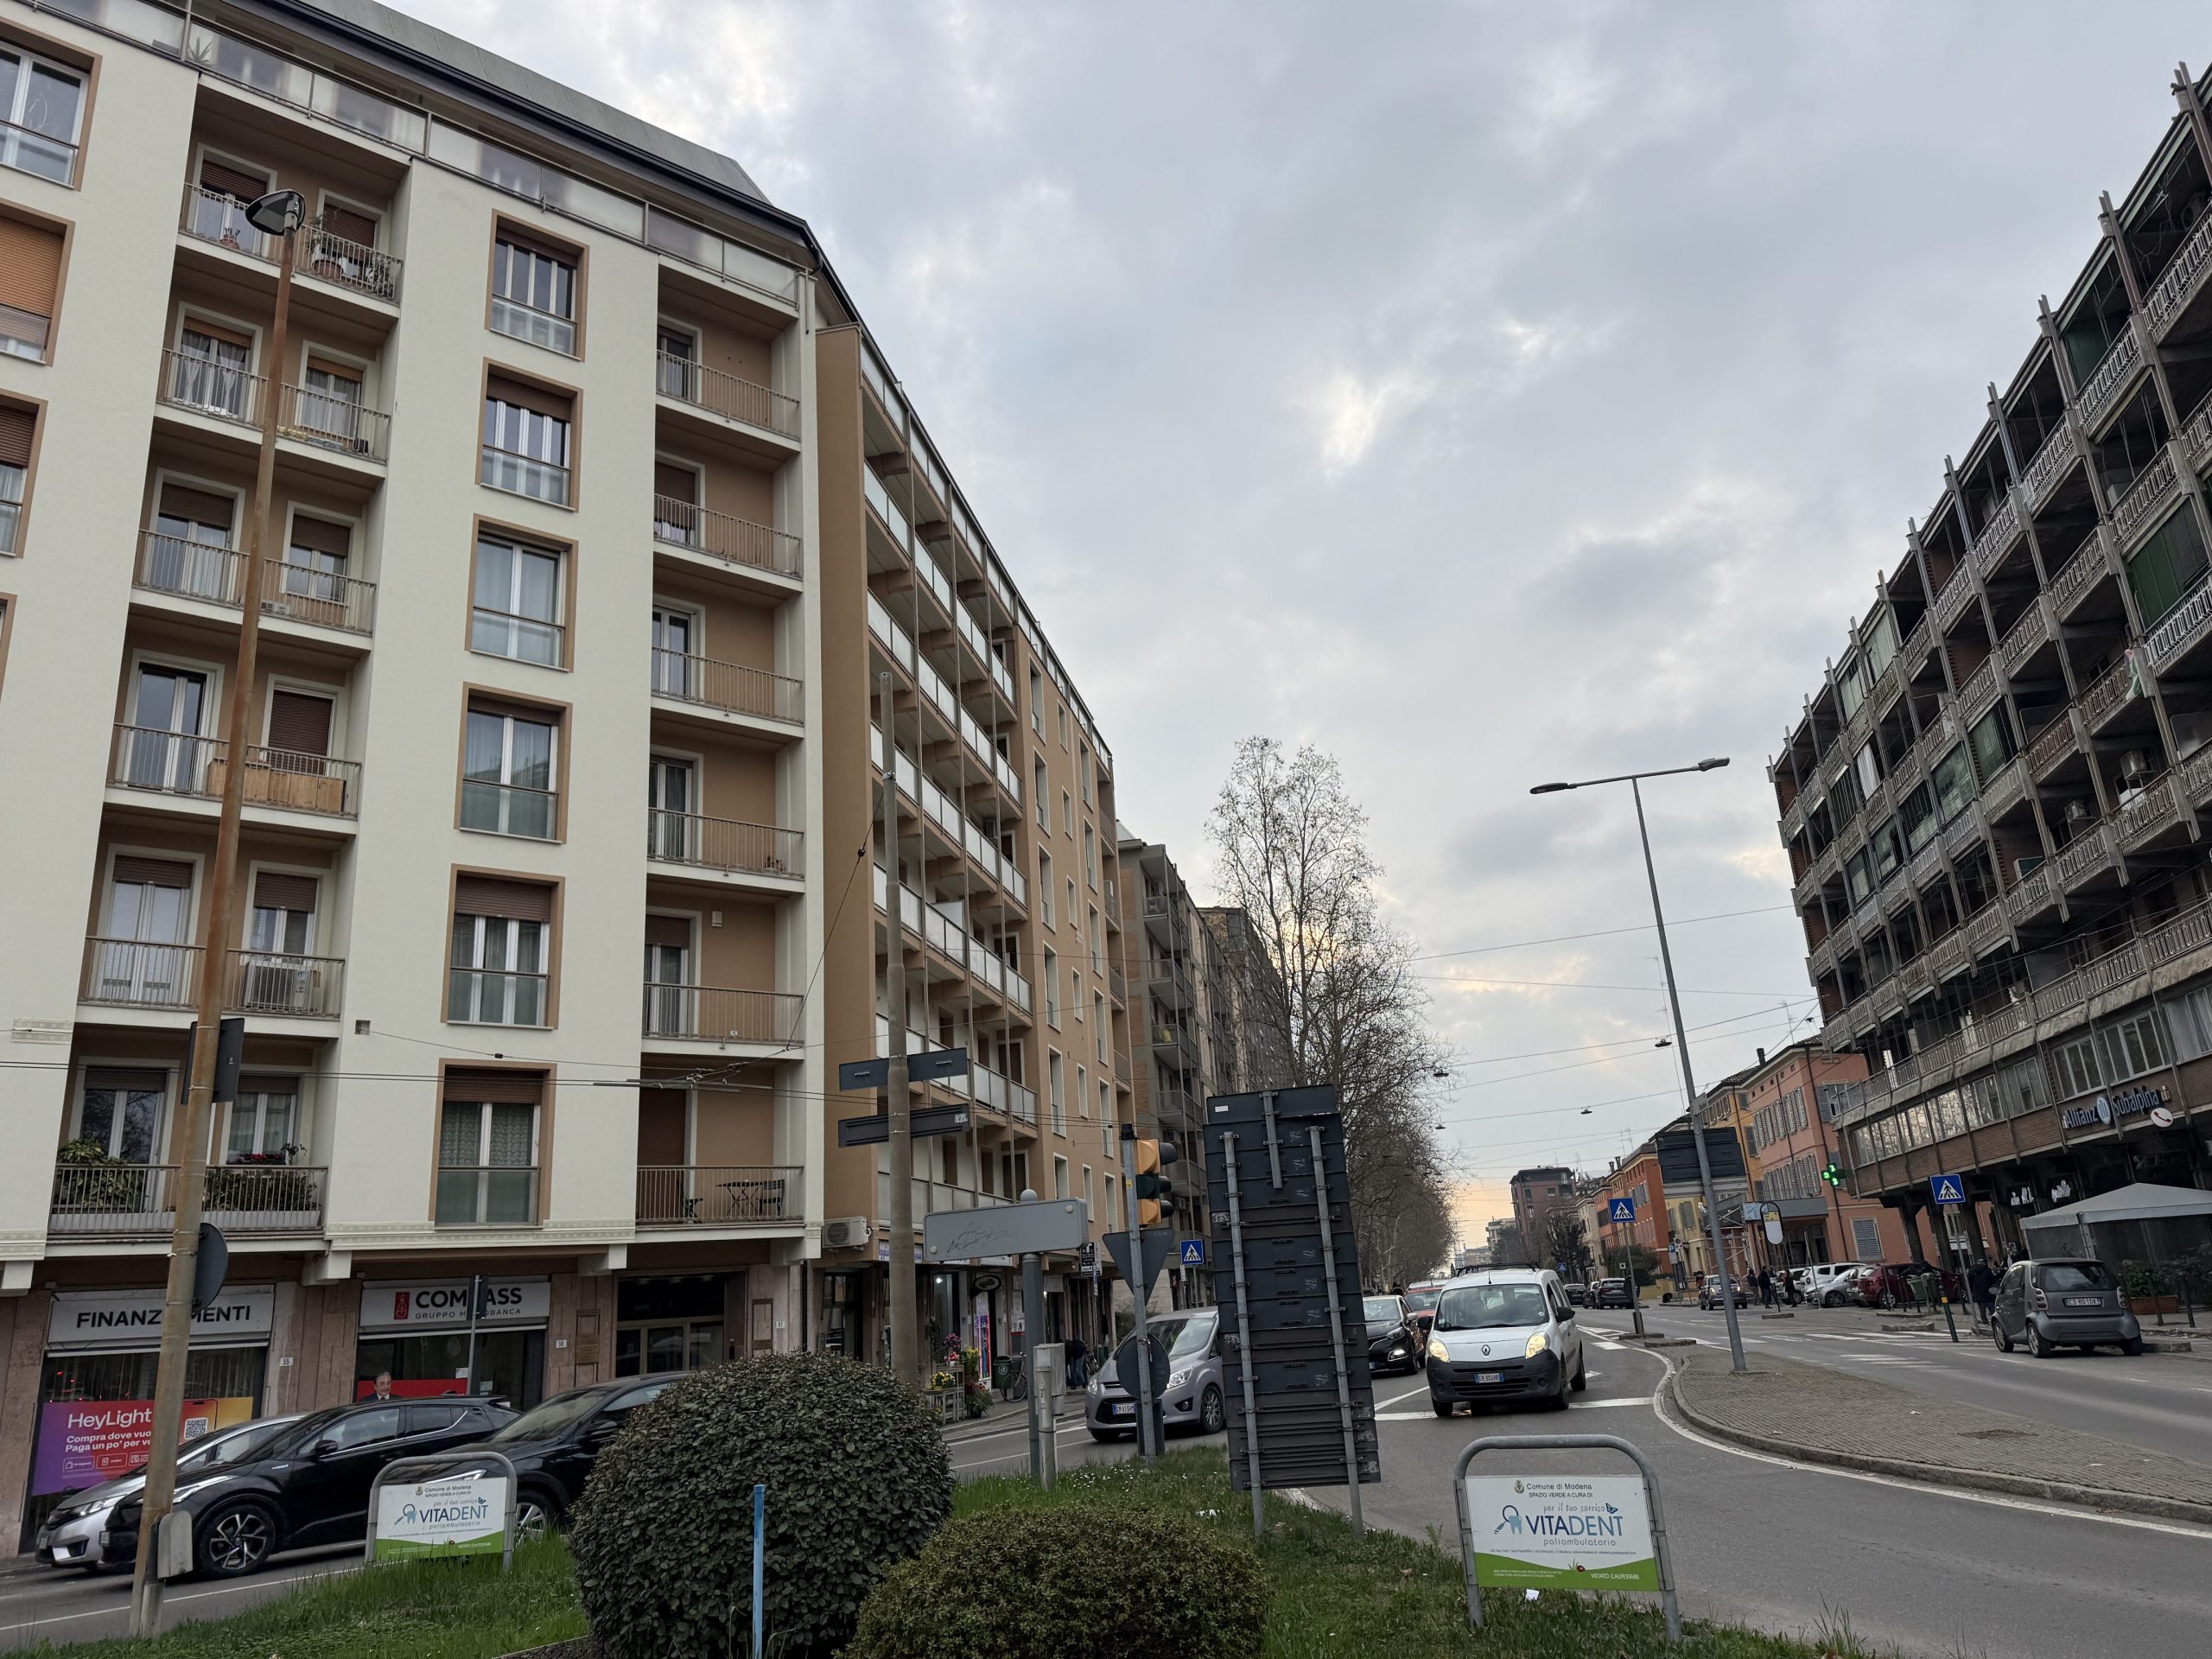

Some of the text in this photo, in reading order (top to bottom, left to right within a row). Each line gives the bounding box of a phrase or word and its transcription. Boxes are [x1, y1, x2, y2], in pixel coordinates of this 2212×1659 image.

[2064, 1088, 2160, 1128] Allianz Subalpina
[415, 1287, 522, 1308] COMASS
[76, 1306, 251, 1328] FINANZMENTI
[415, 1311, 455, 1319] GRUPPO
[67, 1408, 152, 1430] HeyLight
[67, 1433, 105, 1444] Compra
[108, 1432, 131, 1440] dove
[66, 1443, 91, 1452] Paga
[106, 1440, 123, 1452] po'
[124, 1440, 139, 1449] per
[419, 1505, 489, 1522] VITADENT
[1543, 1504, 1554, 1513] per
[1557, 1502, 1564, 1512] il
[1566, 1503, 1578, 1512] tuo
[429, 1521, 480, 1529] poliambulatorio
[1526, 1516, 1623, 1535] VITADENT
[1543, 1537, 1617, 1547] poliambulatorio
